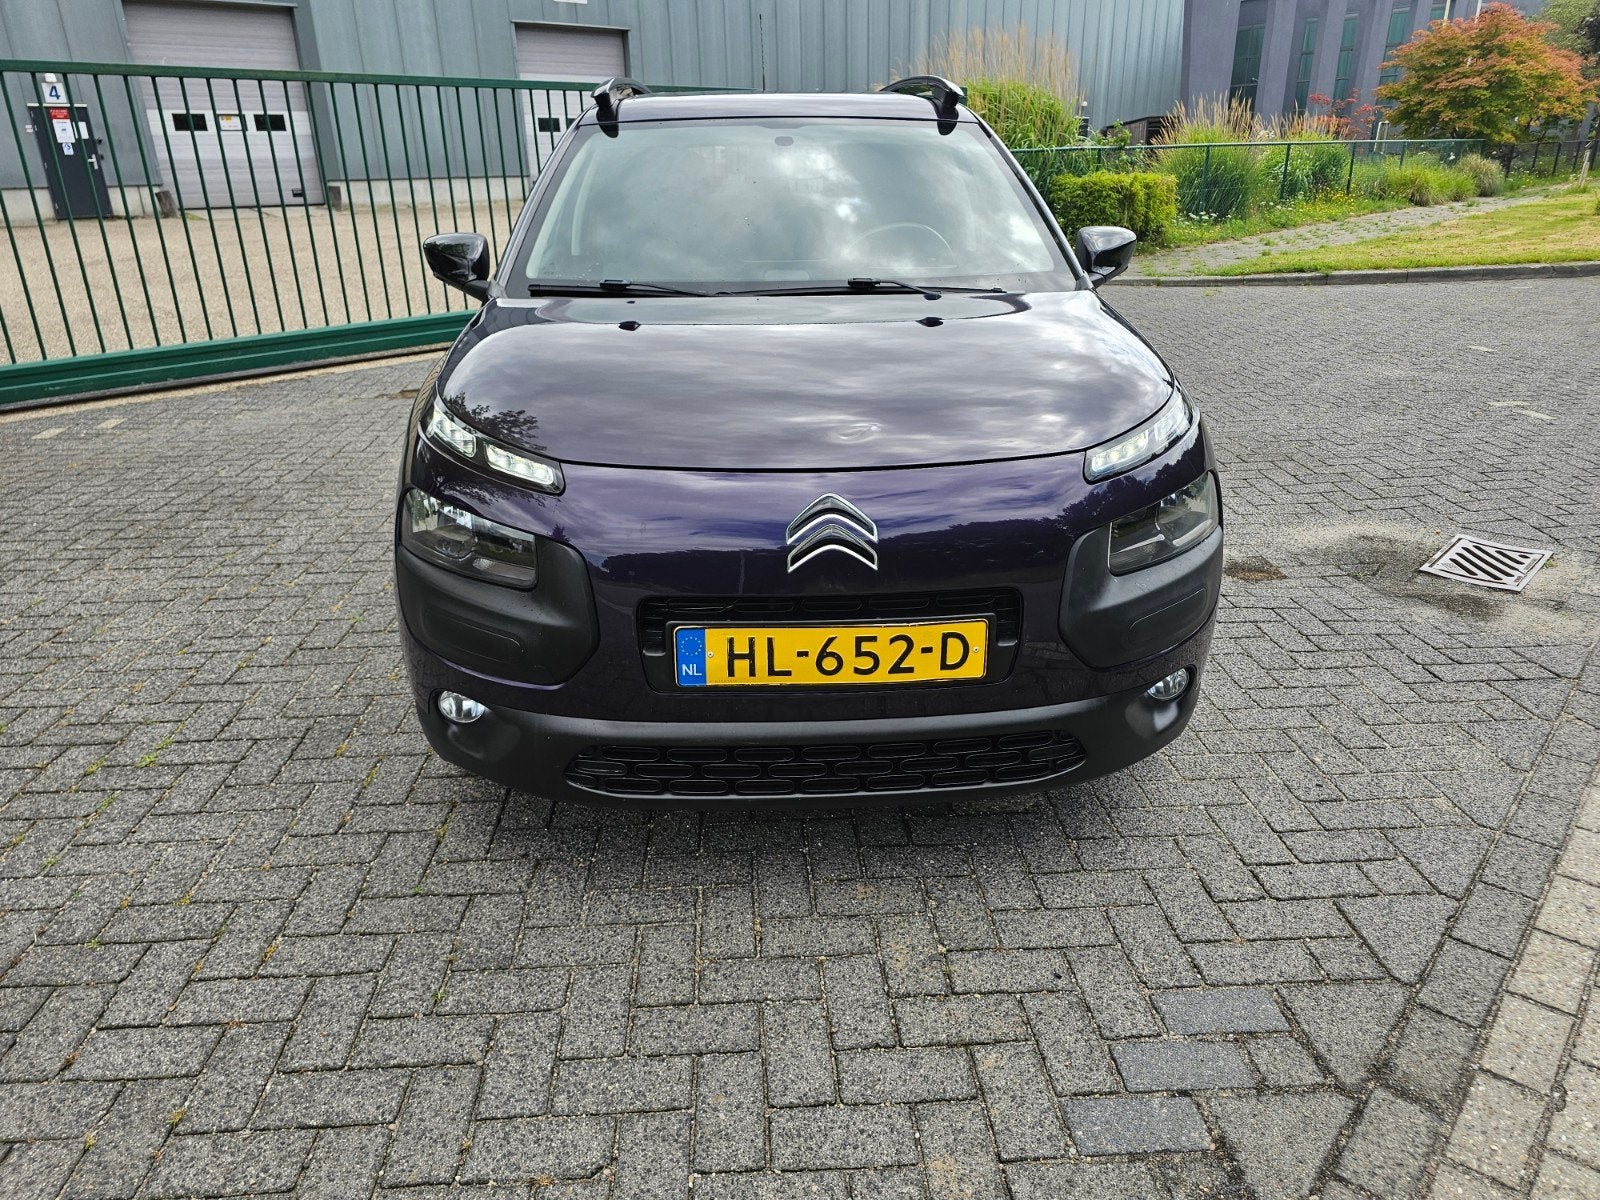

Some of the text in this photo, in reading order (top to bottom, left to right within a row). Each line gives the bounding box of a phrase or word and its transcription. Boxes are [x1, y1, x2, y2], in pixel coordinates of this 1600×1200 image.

[49, 85, 61, 100] 4
[727, 631, 970, 677] HL-652-D
[682, 664, 702, 676] NL
